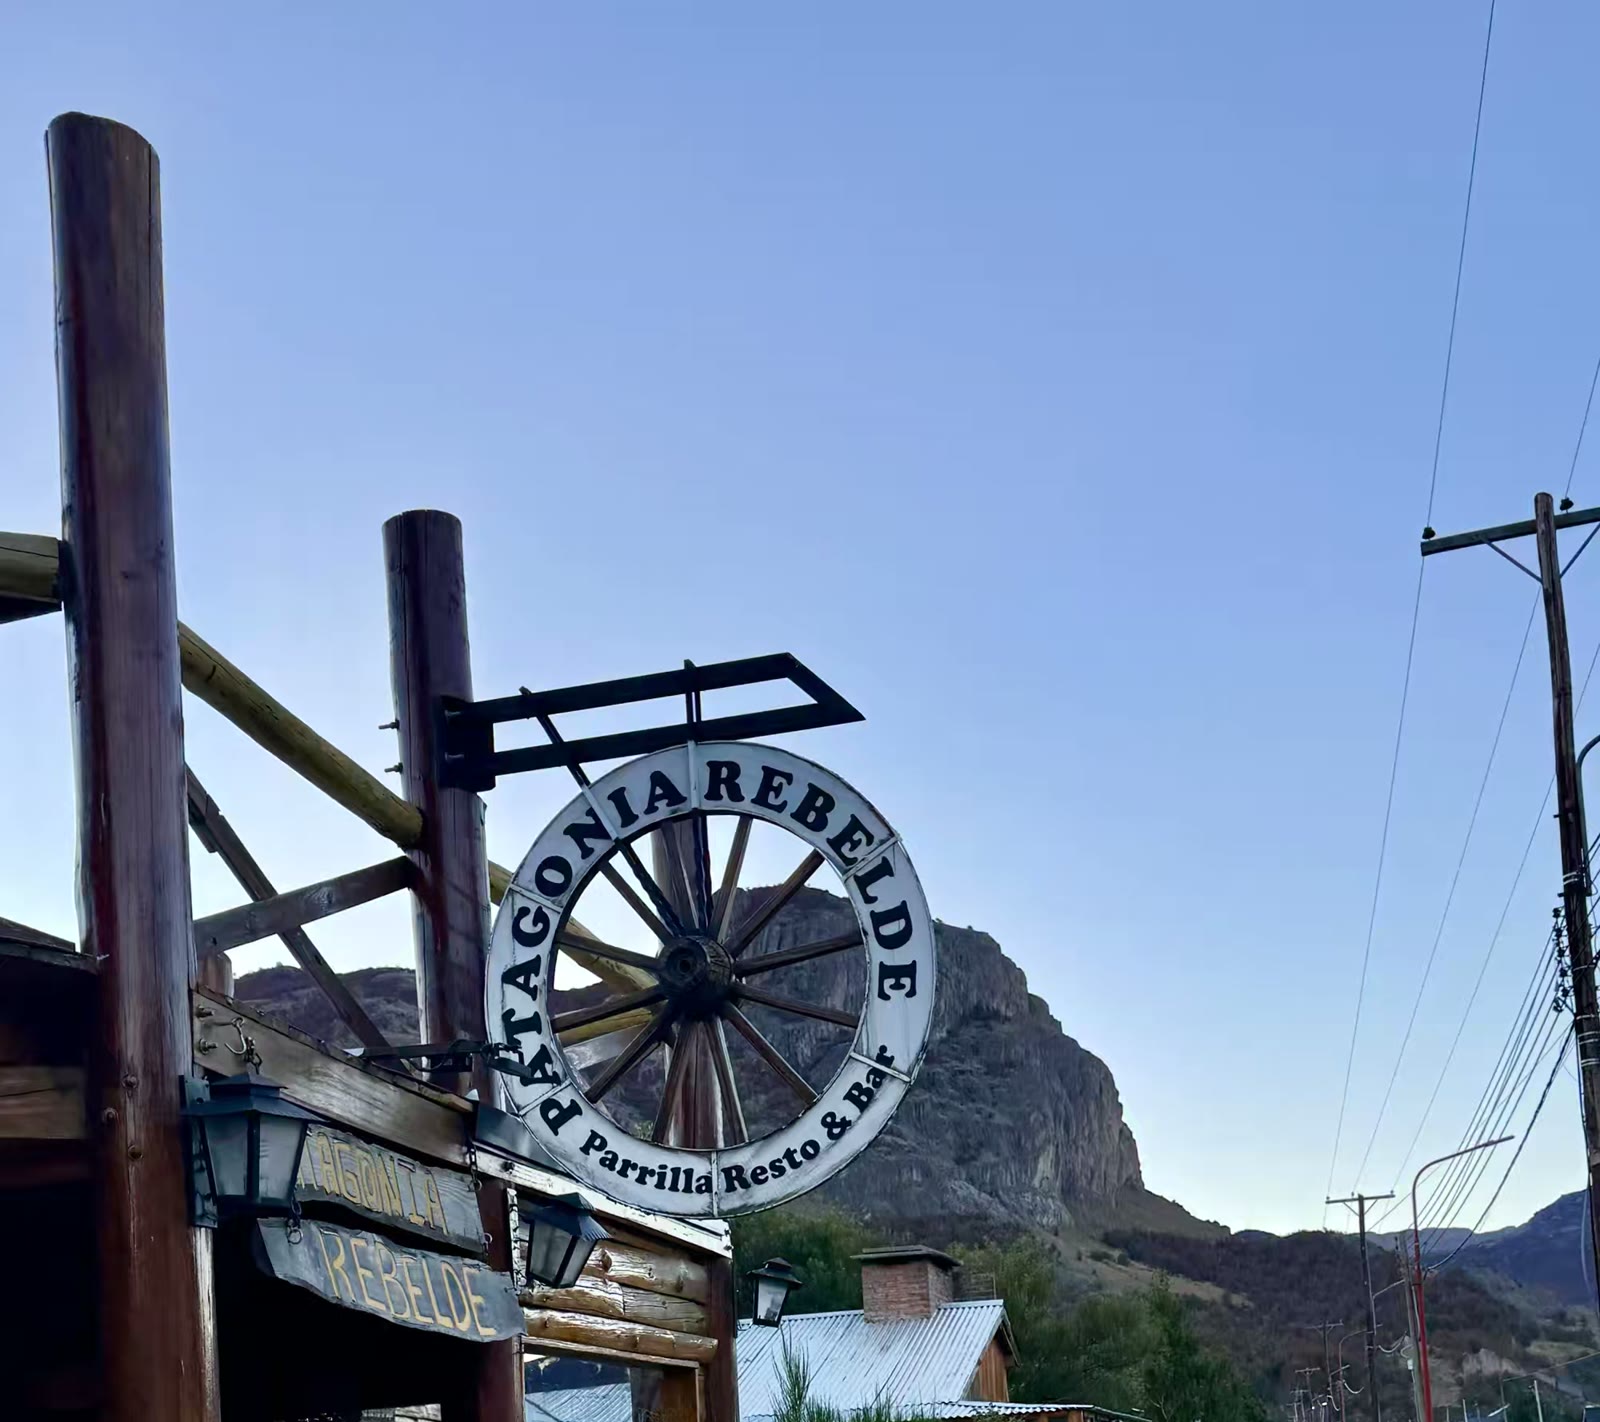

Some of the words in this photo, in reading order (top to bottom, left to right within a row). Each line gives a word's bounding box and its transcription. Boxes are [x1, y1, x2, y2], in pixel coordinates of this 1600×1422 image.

[502, 770, 688, 1137] PATAGONIA
[705, 760, 918, 1001] REBELDE
[580, 1129, 713, 1194] Parrilla
[721, 1134, 821, 1193] Resto
[821, 1111, 851, 1140] &
[319, 1228, 497, 1336] REBELDE
